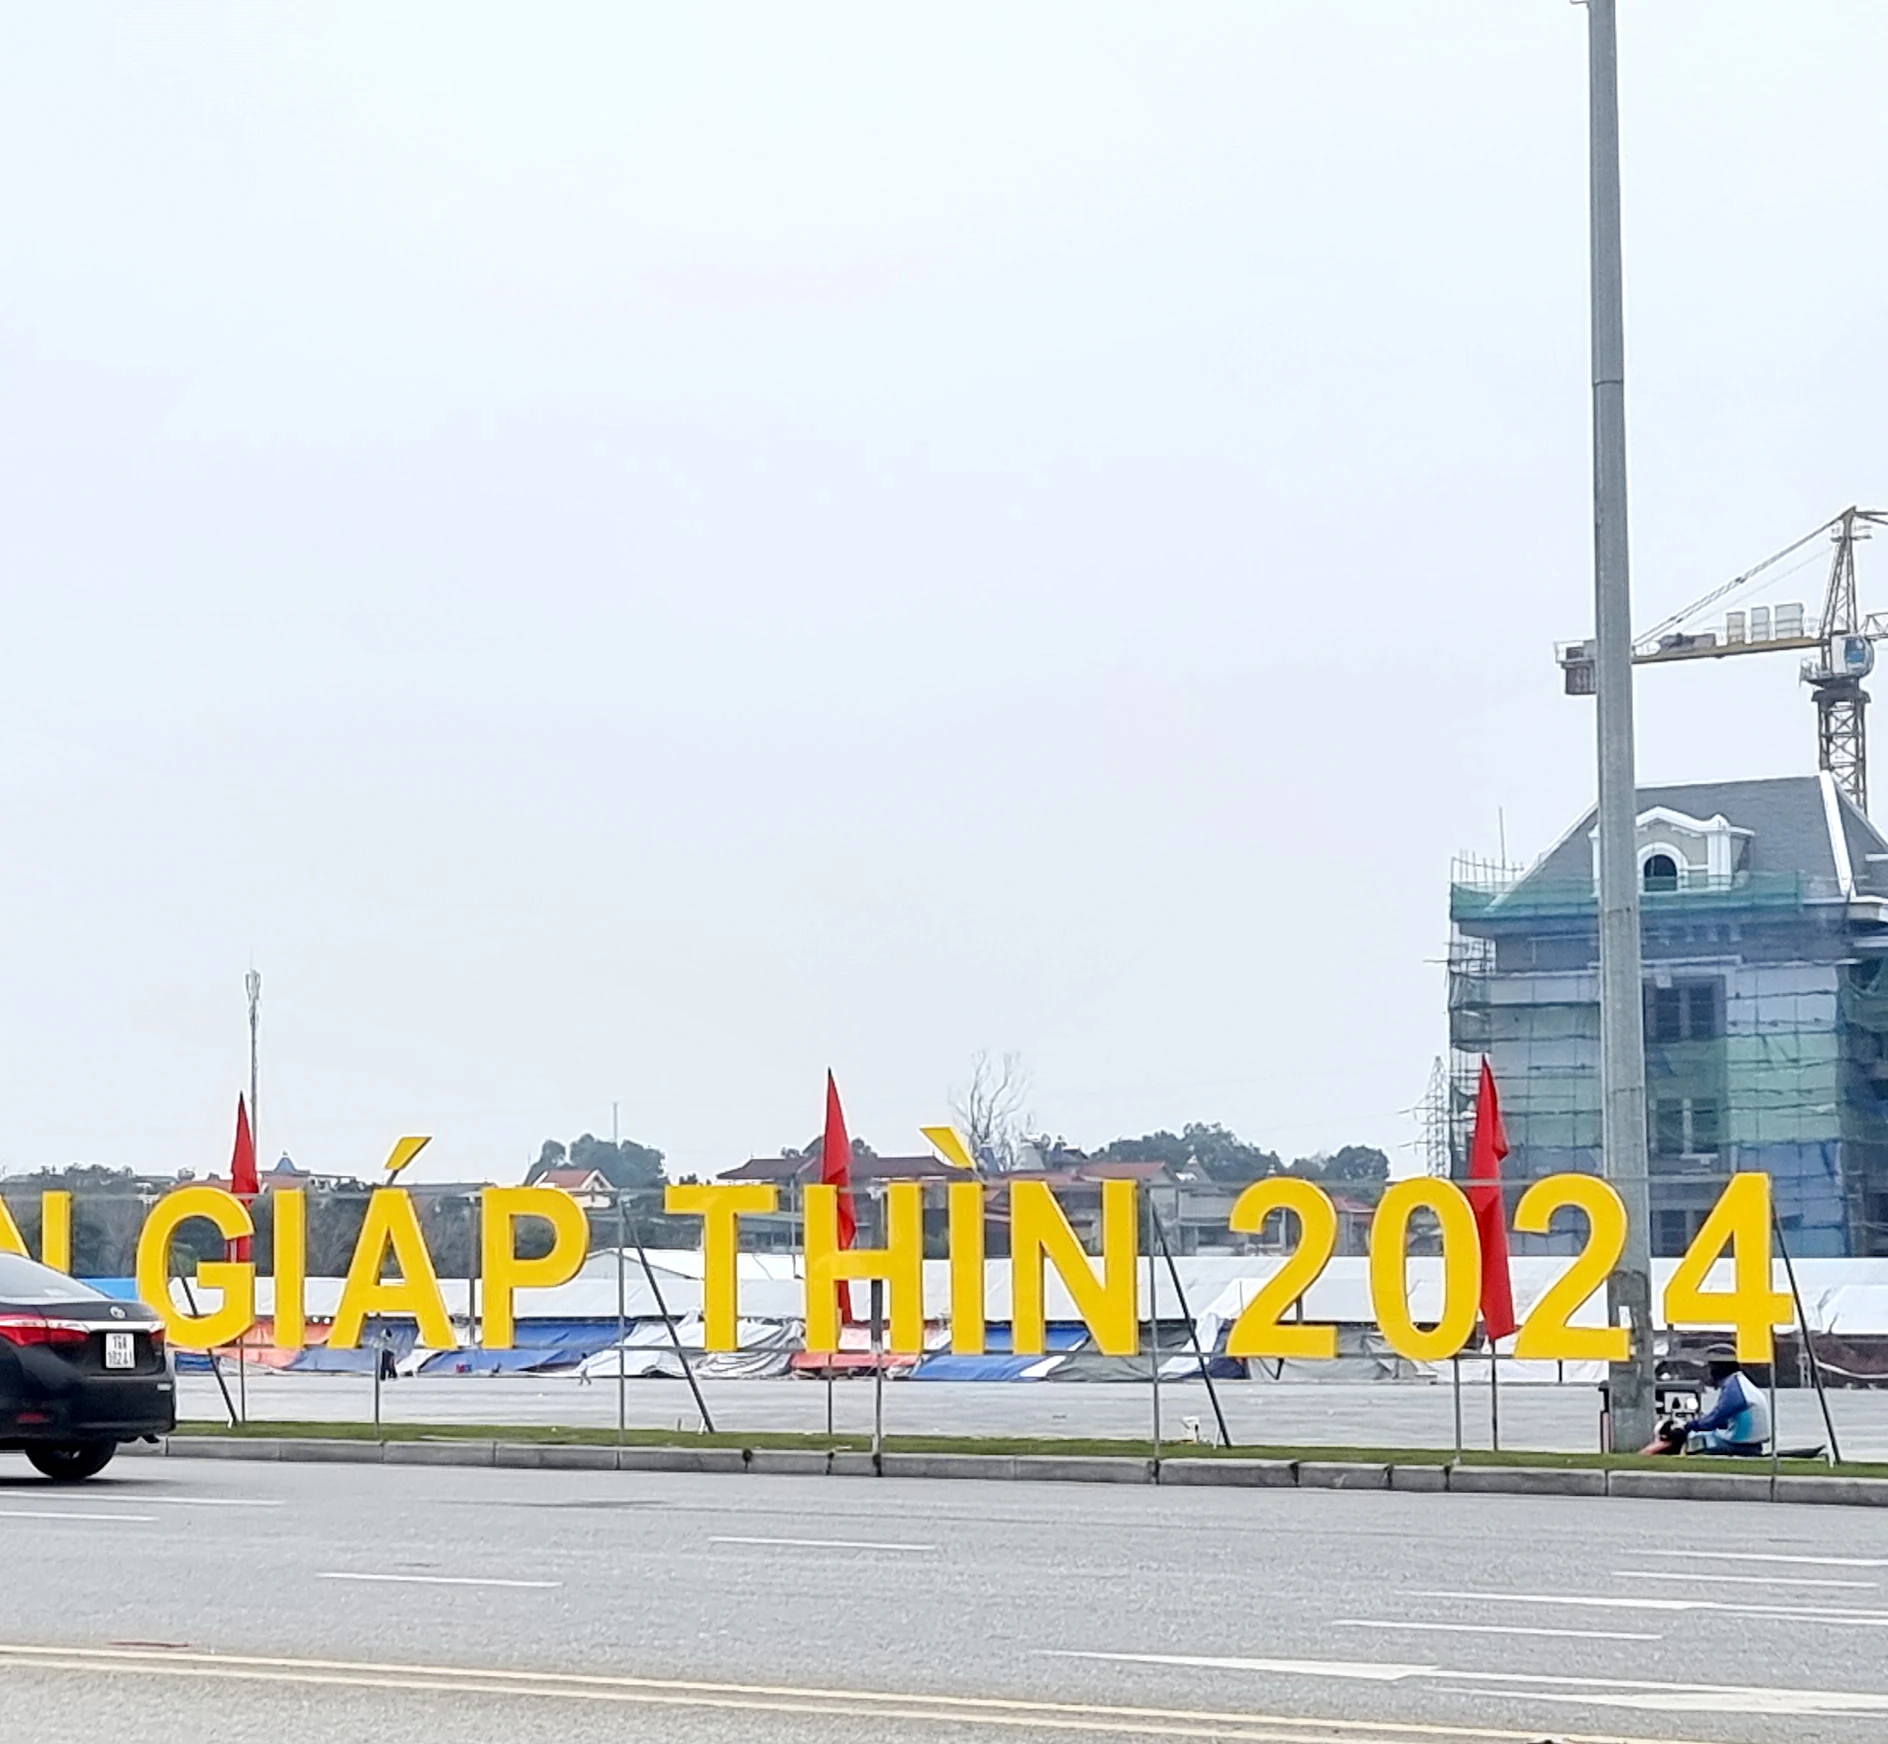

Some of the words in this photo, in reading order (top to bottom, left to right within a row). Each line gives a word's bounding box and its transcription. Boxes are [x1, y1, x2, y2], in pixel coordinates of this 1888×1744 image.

[136, 1136, 590, 1350] GIÁP
[665, 1126, 1139, 1356] THÌN
[1226, 1172, 1795, 1363] 2024
